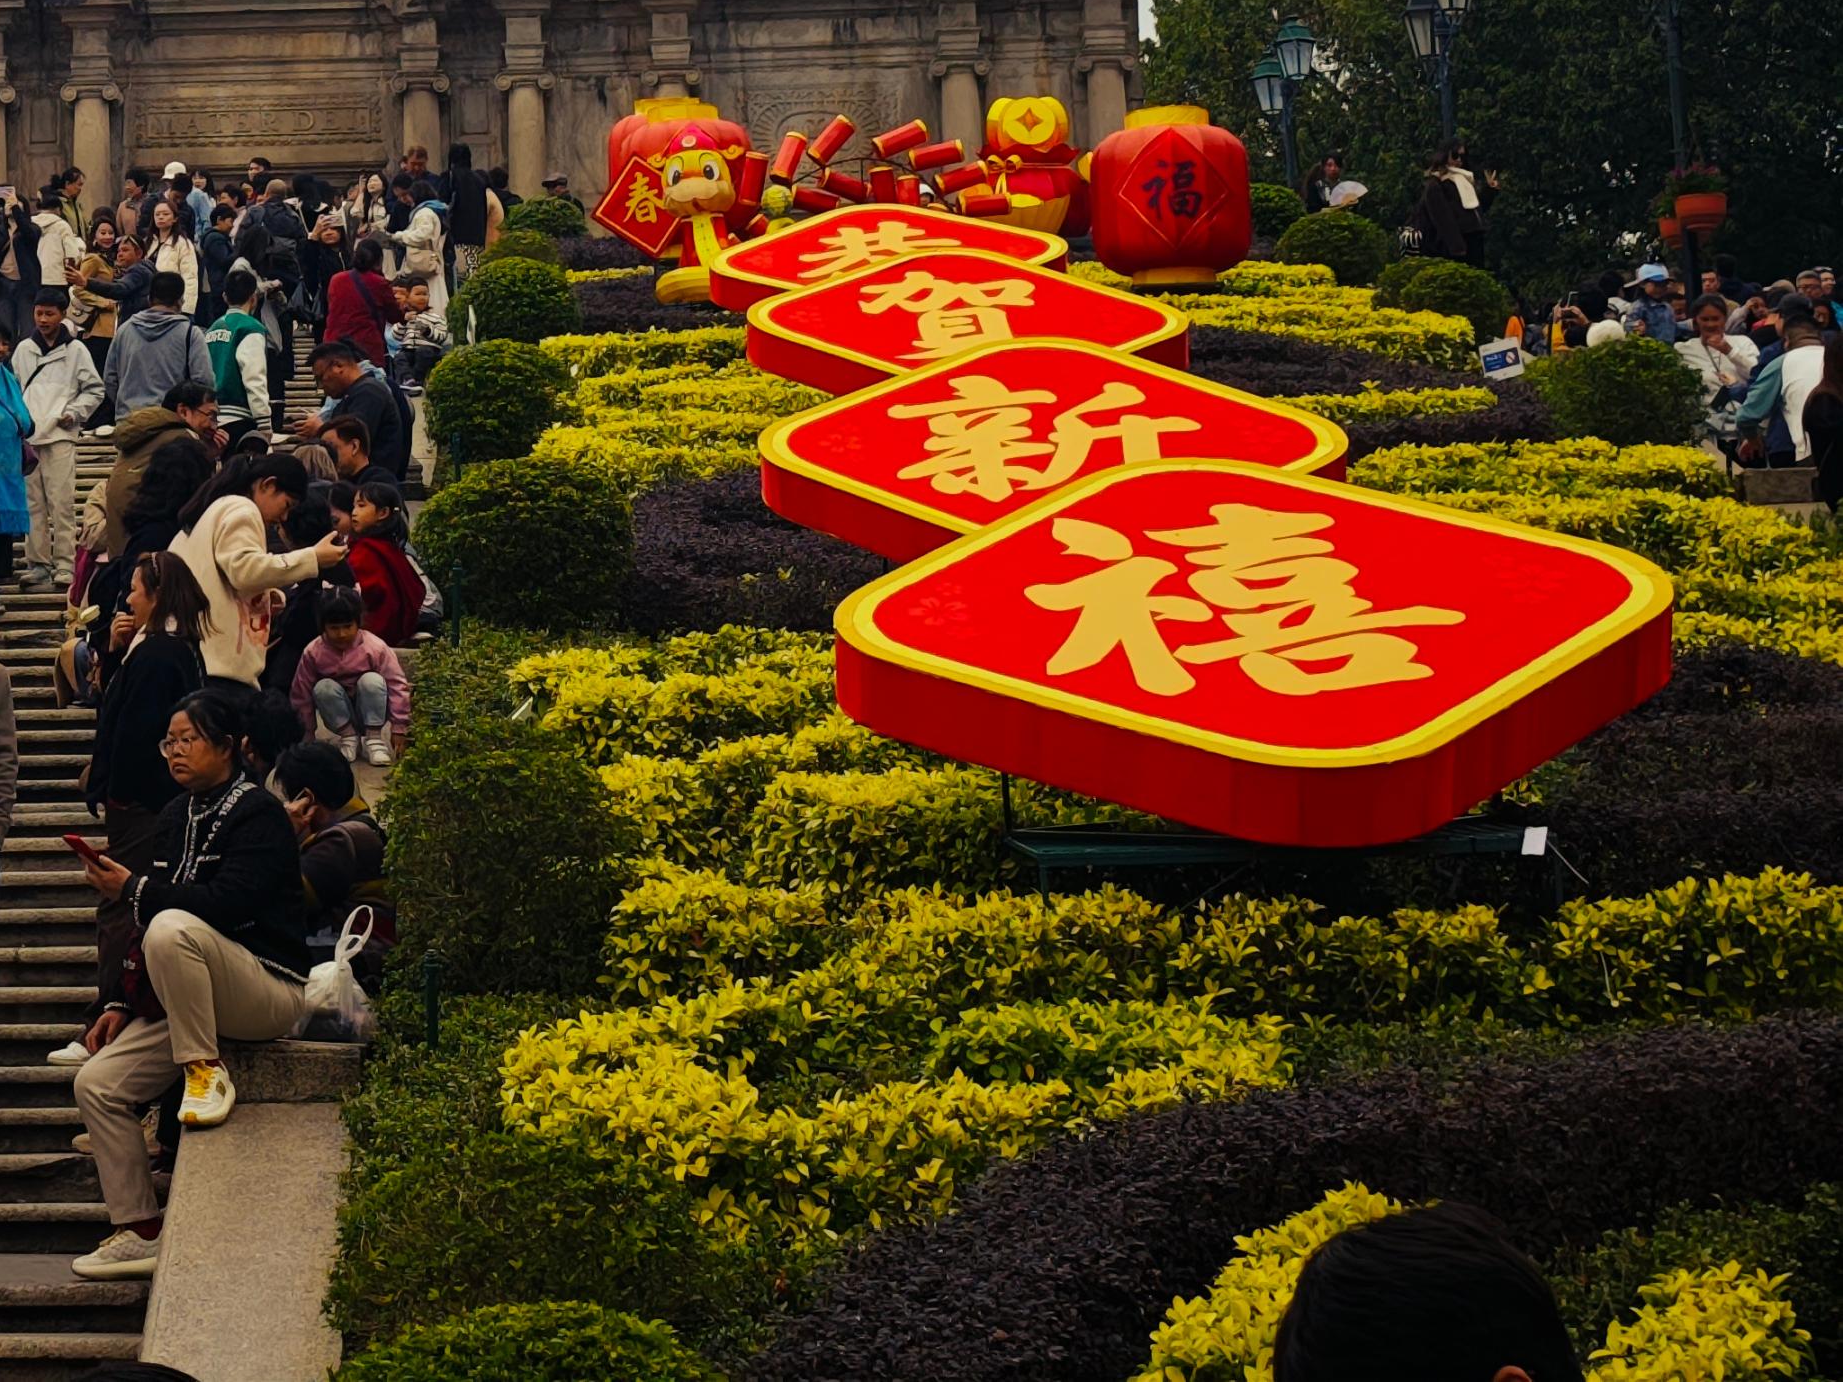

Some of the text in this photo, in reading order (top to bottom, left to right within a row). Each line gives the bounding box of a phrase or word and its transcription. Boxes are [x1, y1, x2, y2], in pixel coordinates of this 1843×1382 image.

[149, 110, 368, 135] MATER DEI
[623, 172, 666, 223] 春
[1142, 161, 1202, 219] 福
[858, 271, 1036, 360] 賀
[887, 375, 1202, 502] 新
[1024, 503, 1466, 696] 禧
